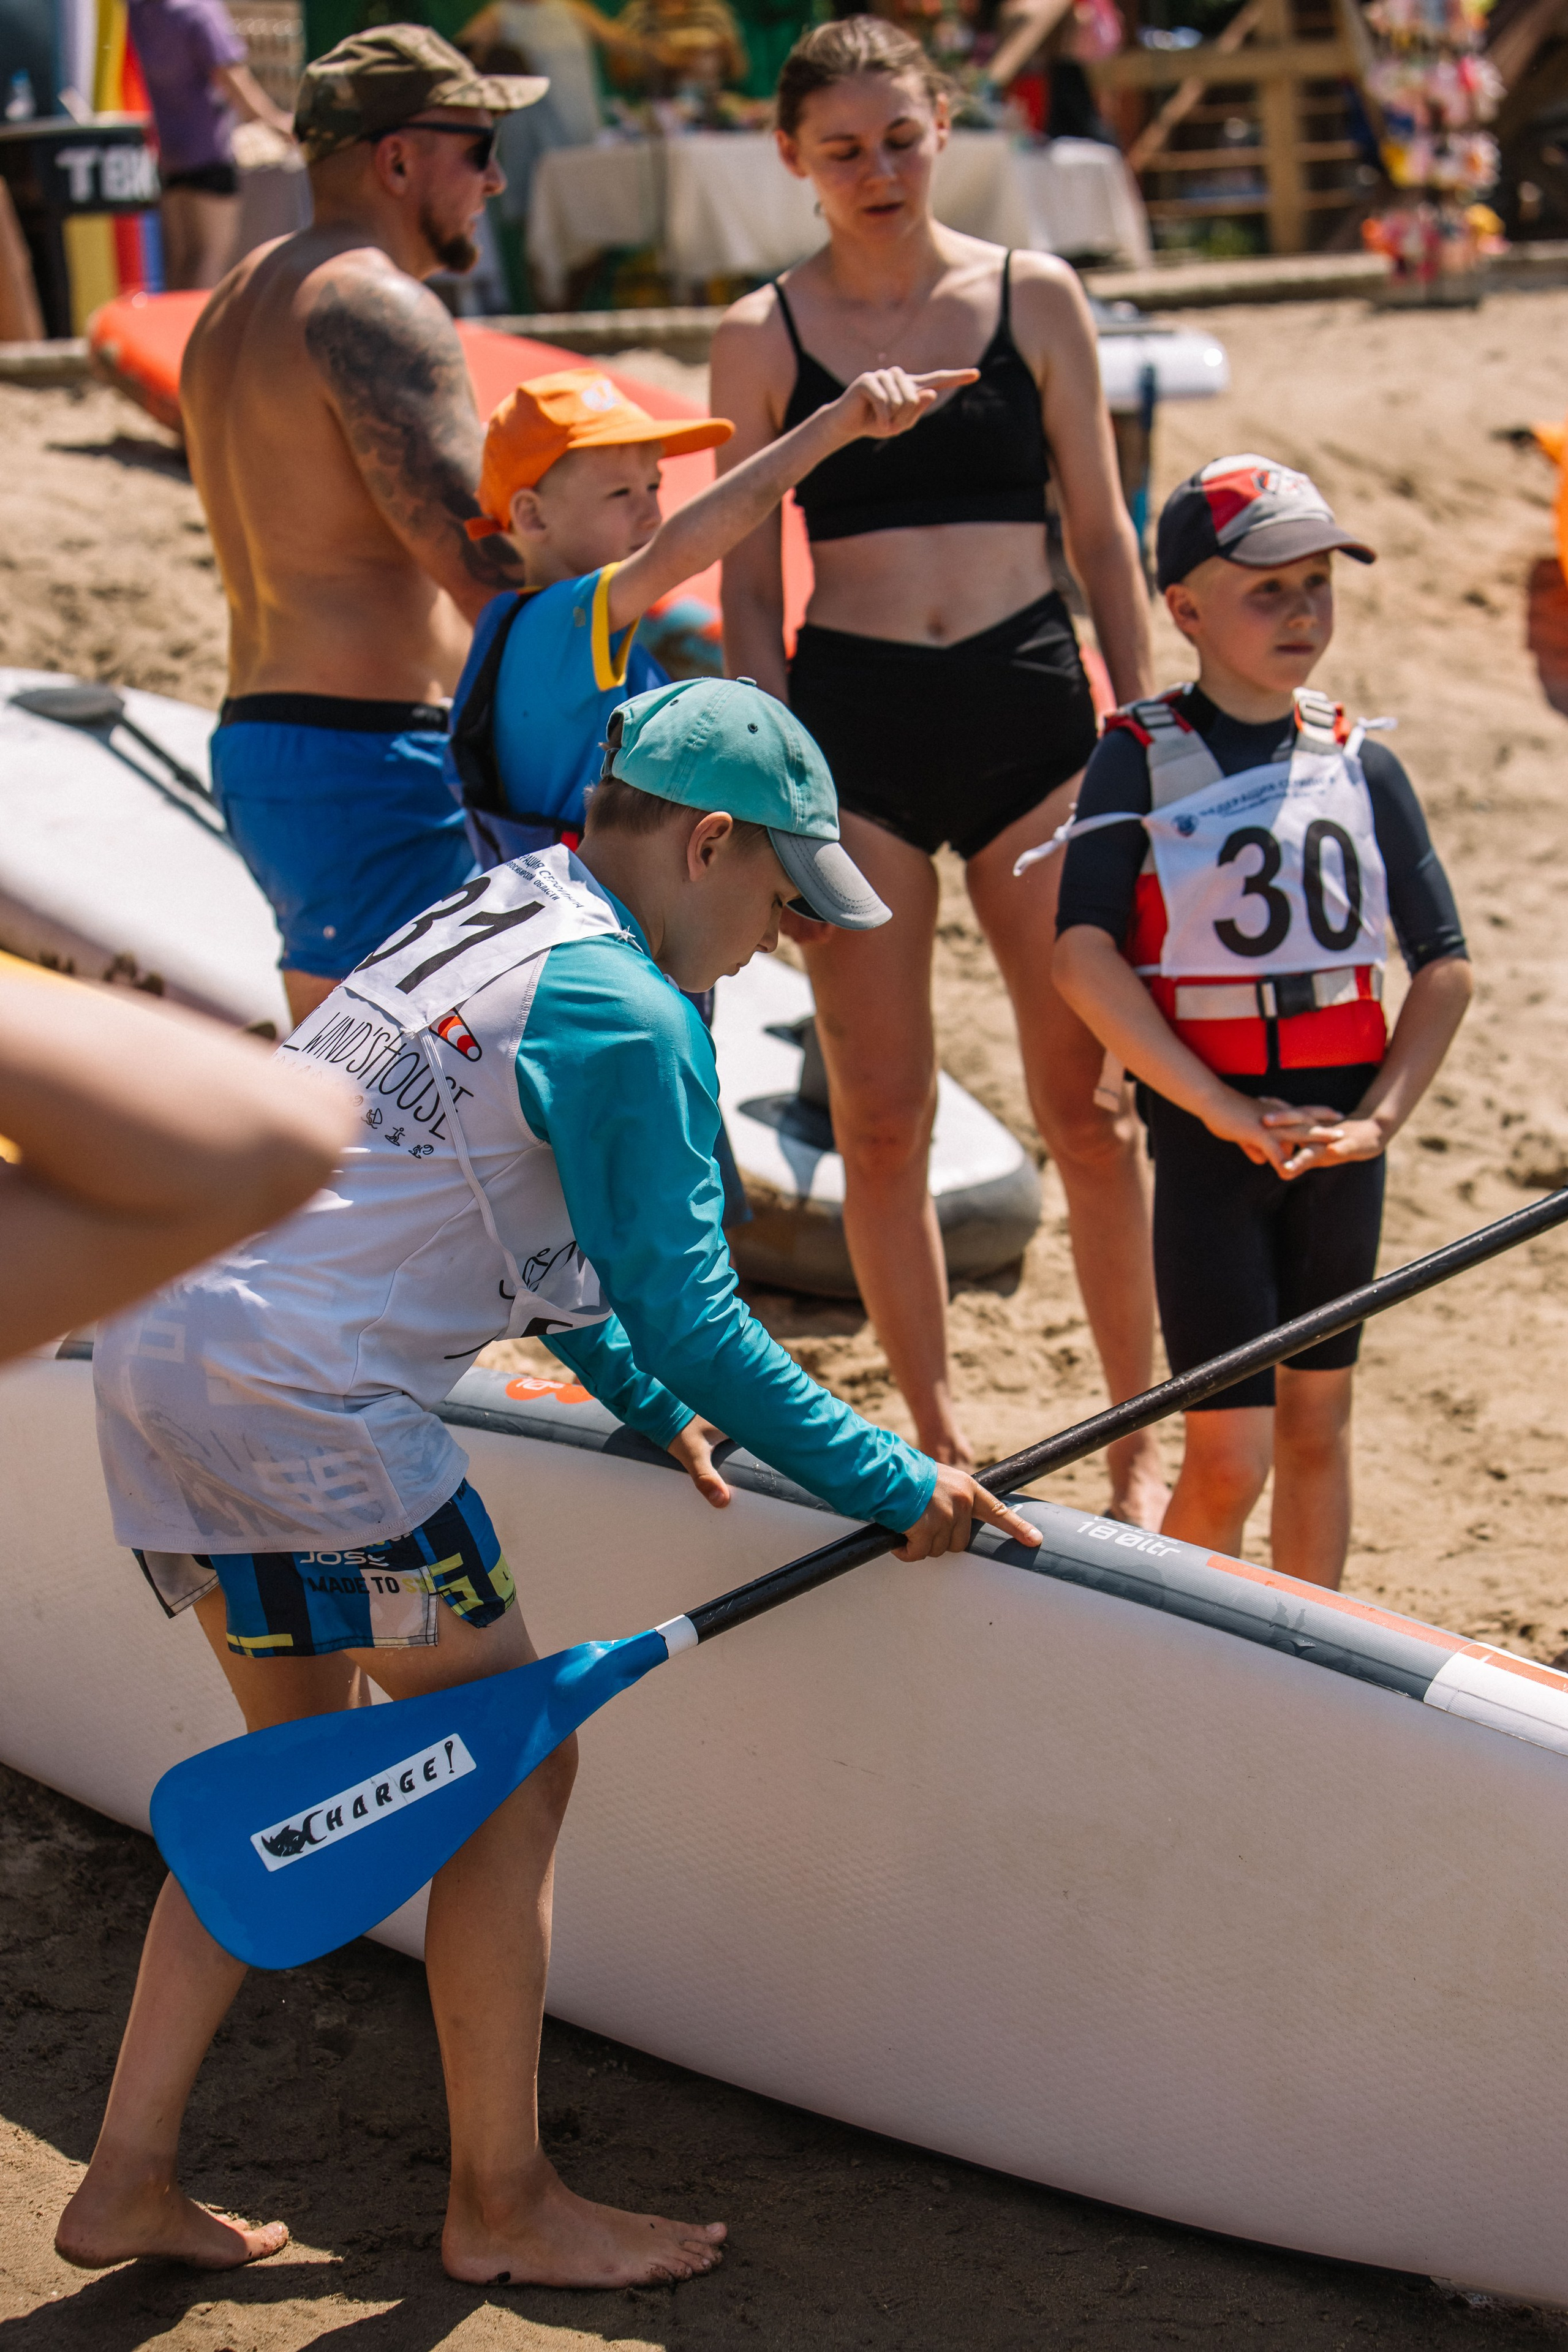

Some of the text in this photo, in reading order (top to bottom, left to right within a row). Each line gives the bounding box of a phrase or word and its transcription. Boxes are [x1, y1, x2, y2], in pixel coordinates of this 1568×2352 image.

[533, 880, 560, 901] ОБЛАСТИ
[1213, 820, 1361, 957] 30
[353, 876, 546, 995] 31
[307, 1576, 370, 1594] MADE
[370, 1576, 401, 1594] TO
